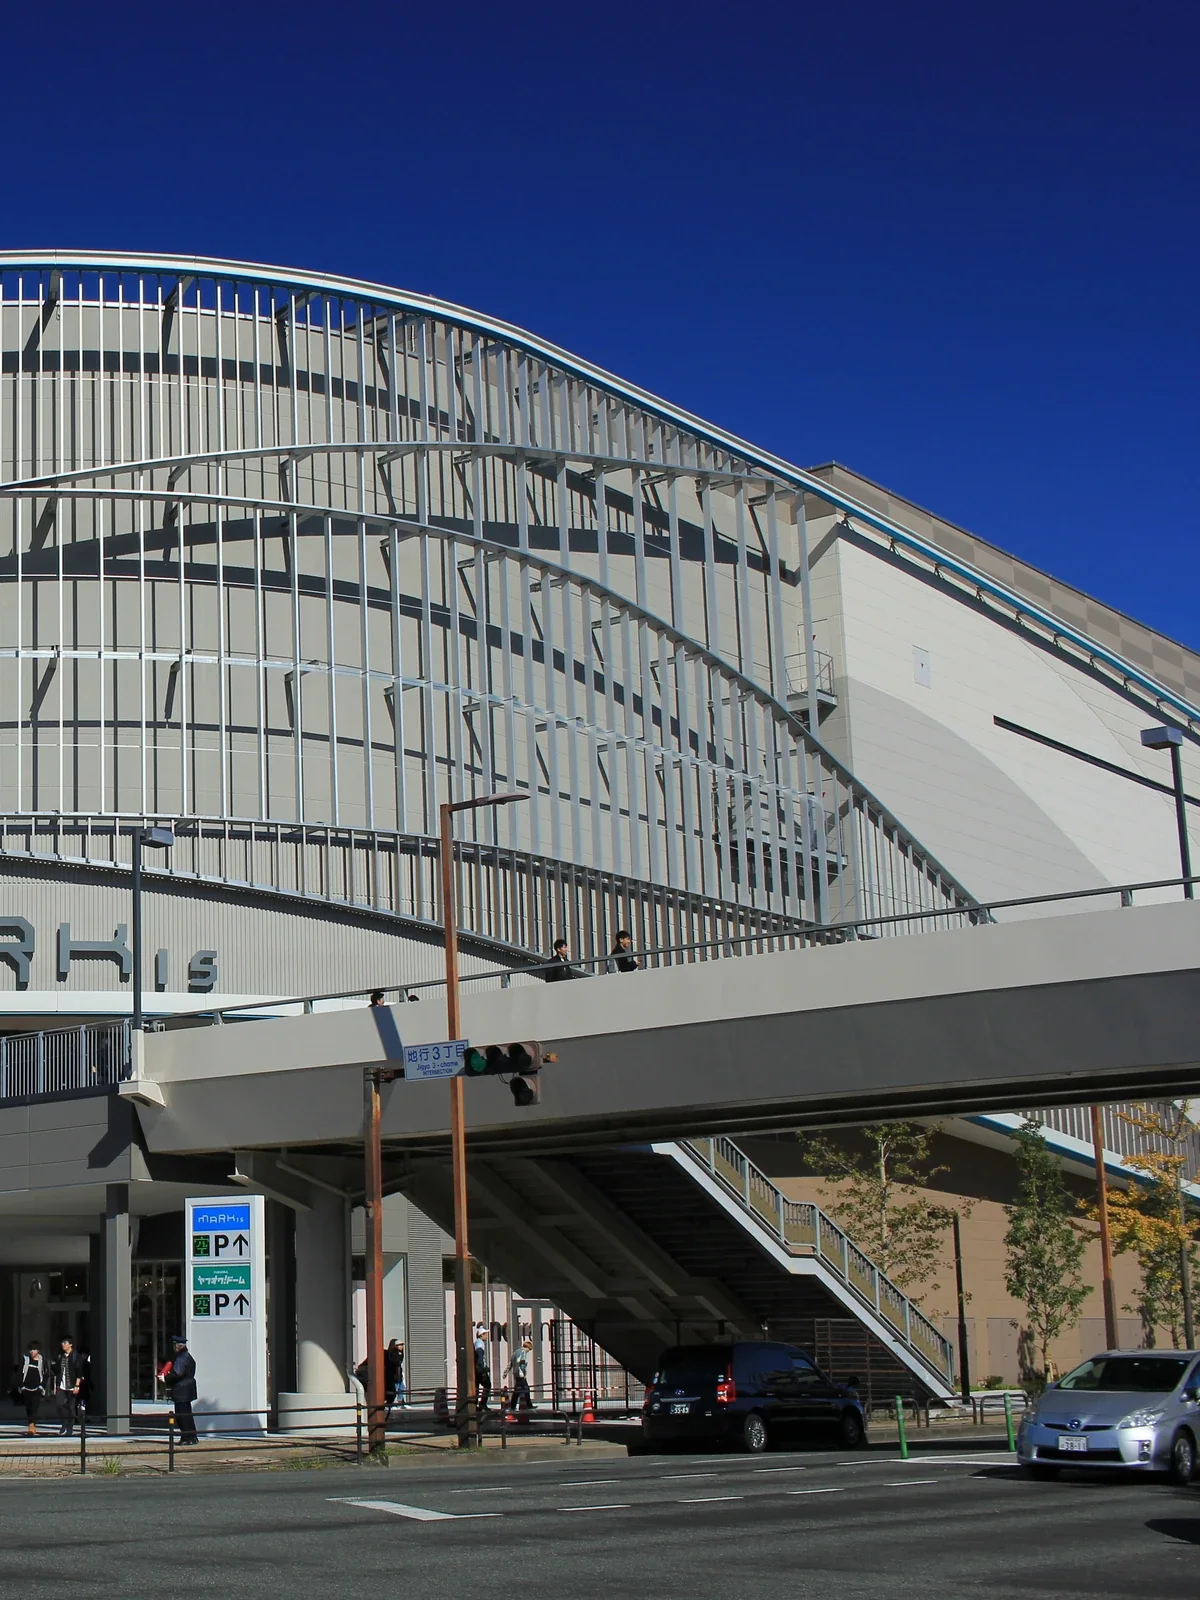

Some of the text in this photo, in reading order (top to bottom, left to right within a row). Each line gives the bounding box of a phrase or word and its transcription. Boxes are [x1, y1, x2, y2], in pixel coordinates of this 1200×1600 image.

[407, 1044, 465, 1063] 地行3丁目
[194, 1235, 229, 1256] 空 P
[194, 1293, 230, 1316] 空 P
